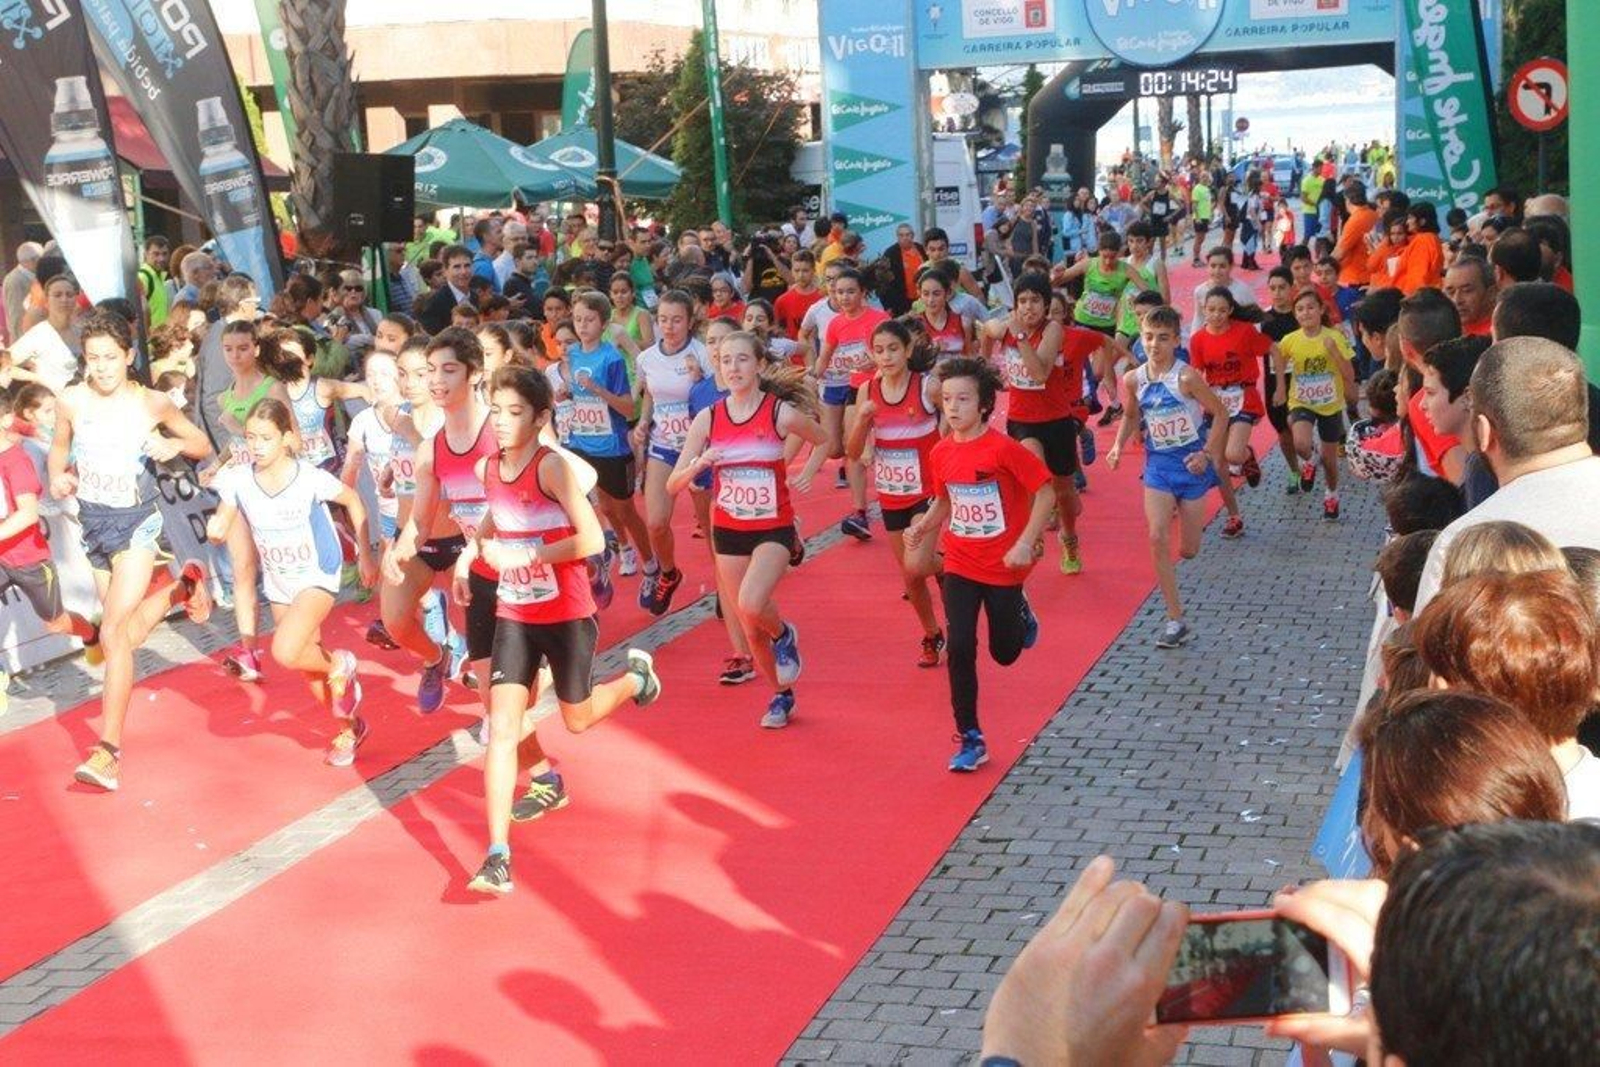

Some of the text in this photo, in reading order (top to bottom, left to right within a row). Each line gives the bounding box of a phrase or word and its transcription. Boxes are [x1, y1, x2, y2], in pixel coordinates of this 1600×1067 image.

[1225, 21, 1350, 38] CARREIRA POPULAR
[963, 37, 1081, 54] CARREIRA POPULAR
[1139, 69, 1234, 96] 00:14:24
[1297, 384, 1334, 400] 2066
[571, 409, 605, 425] 2001
[877, 463, 916, 482] 2056
[721, 485, 770, 505] 2003
[953, 502, 998, 522] 2085
